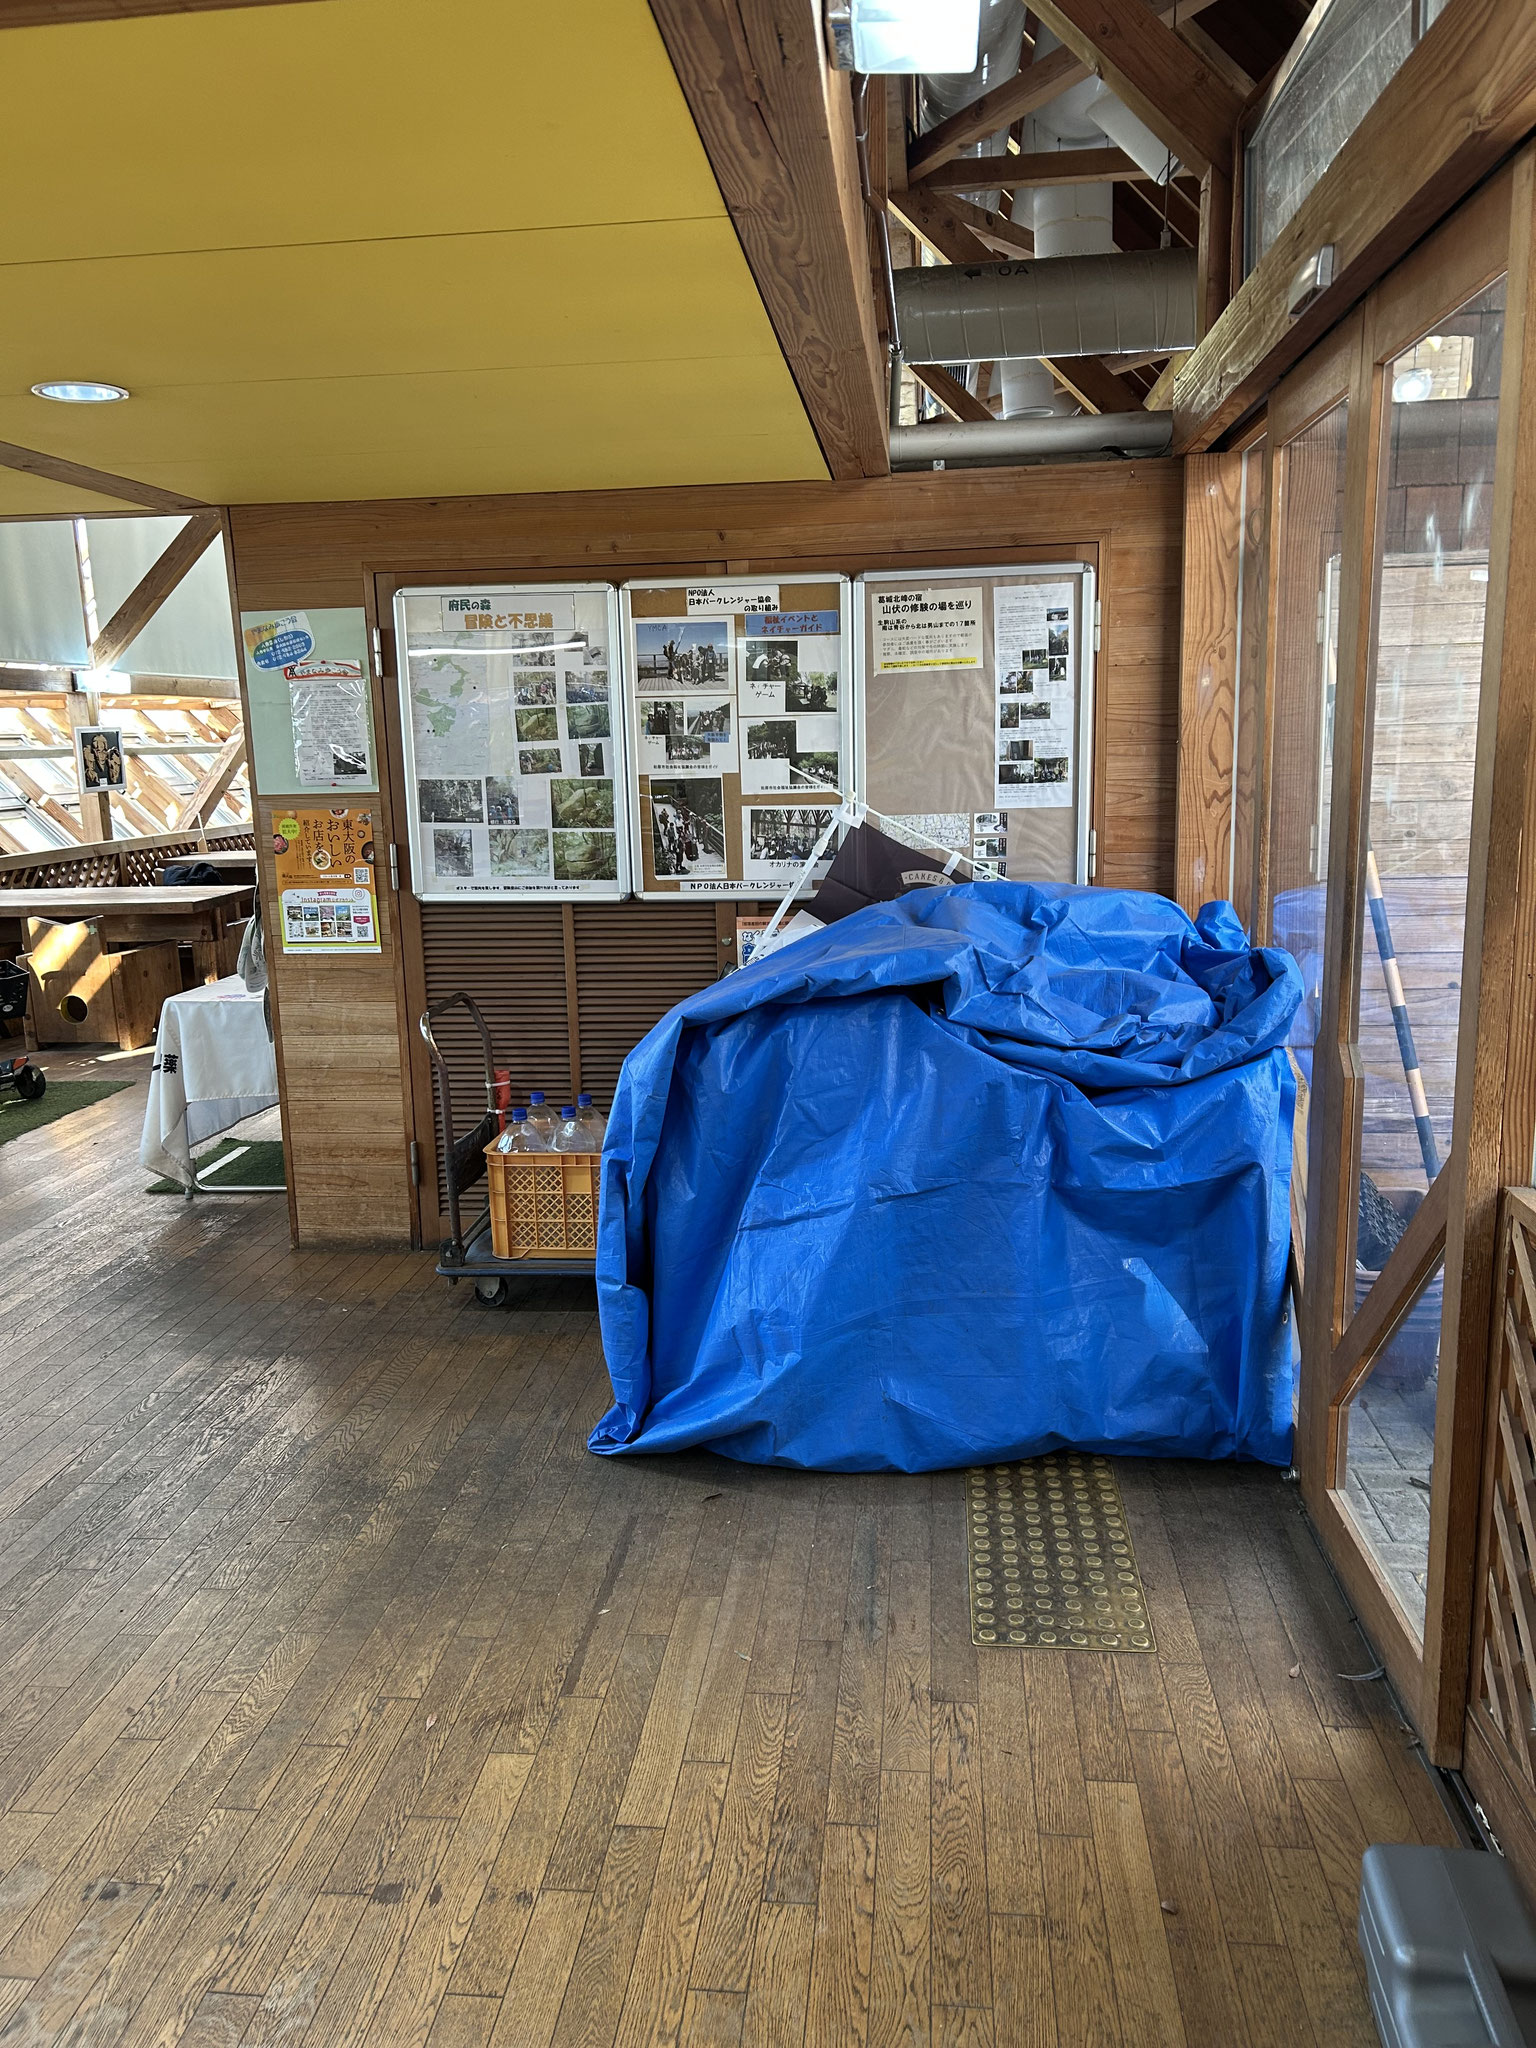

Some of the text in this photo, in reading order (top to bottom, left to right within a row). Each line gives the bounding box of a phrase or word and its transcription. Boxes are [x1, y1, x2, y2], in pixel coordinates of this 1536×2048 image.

[998, 265, 1030, 277] OA
[688, 589, 715, 597] NPO法人
[448, 599, 492, 611] 府民の森
[688, 595, 772, 606] 日本パークレンジャー協会
[744, 604, 779, 612] の取り組み
[882, 600, 972, 615] 山伏の修験の場を巡り
[464, 613, 554, 630] 冒険と不思議
[764, 615, 819, 625] 福祉イベントと
[647, 624, 668, 633] YMCA
[761, 623, 823, 633] ネイチャーガイド
[313, 819, 325, 853] お店を
[342, 818, 356, 864] 東大阪の
[327, 818, 342, 868] おいしい
[769, 861, 819, 869] オカリナの演会
[908, 872, 937, 882] CAKES
